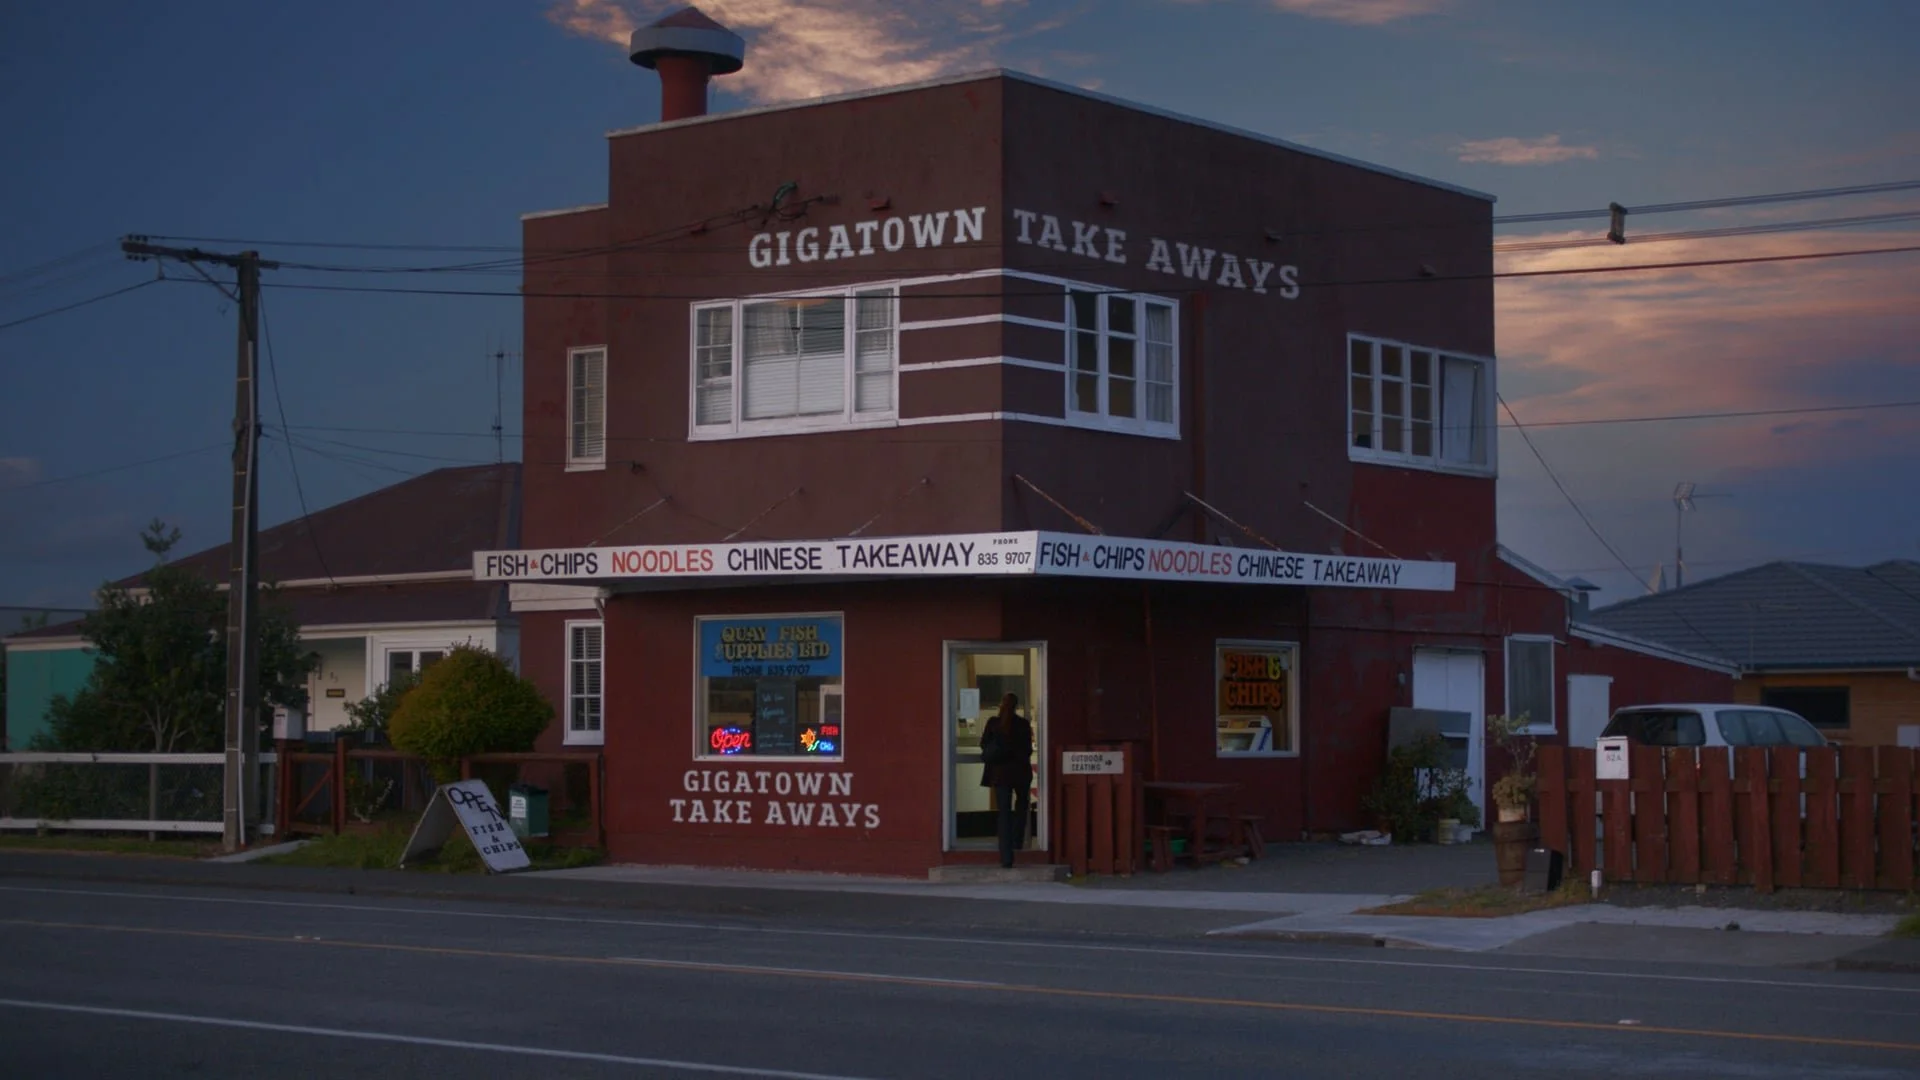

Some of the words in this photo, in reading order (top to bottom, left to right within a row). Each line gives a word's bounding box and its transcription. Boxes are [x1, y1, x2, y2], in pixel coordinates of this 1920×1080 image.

[748, 206, 986, 269] GIGATOWN
[1012, 207, 1128, 265] TAKE
[1145, 236, 1300, 300] AWAYS
[486, 554, 528, 577] FISH
[540, 552, 598, 575] CHIPS
[612, 549, 714, 574] NOODLES
[727, 546, 822, 571] CHINESE
[836, 541, 975, 569] TAKEAWAY
[977, 553, 998, 566] 835
[1005, 551, 1031, 565] 9707
[1039, 542, 1080, 569] FISH
[1092, 545, 1145, 571] CHIPS
[1149, 549, 1232, 575] NOODLES
[1237, 555, 1304, 580] CHINESE
[1313, 558, 1402, 586] TAKEAWAY
[722, 626, 766, 642] QUAY
[780, 624, 817, 642] FISH
[797, 641, 831, 660] LTD
[731, 664, 763, 677] PHONE
[1225, 681, 1282, 710] CHIPS
[711, 728, 752, 750] Open
[683, 770, 854, 796] GIGATOWN
[448, 787, 505, 821] OPEN
[669, 799, 752, 824] TAKE
[764, 801, 881, 829] AWAYS
[472, 822, 505, 835] FISH
[483, 841, 521, 855] CHIPS
